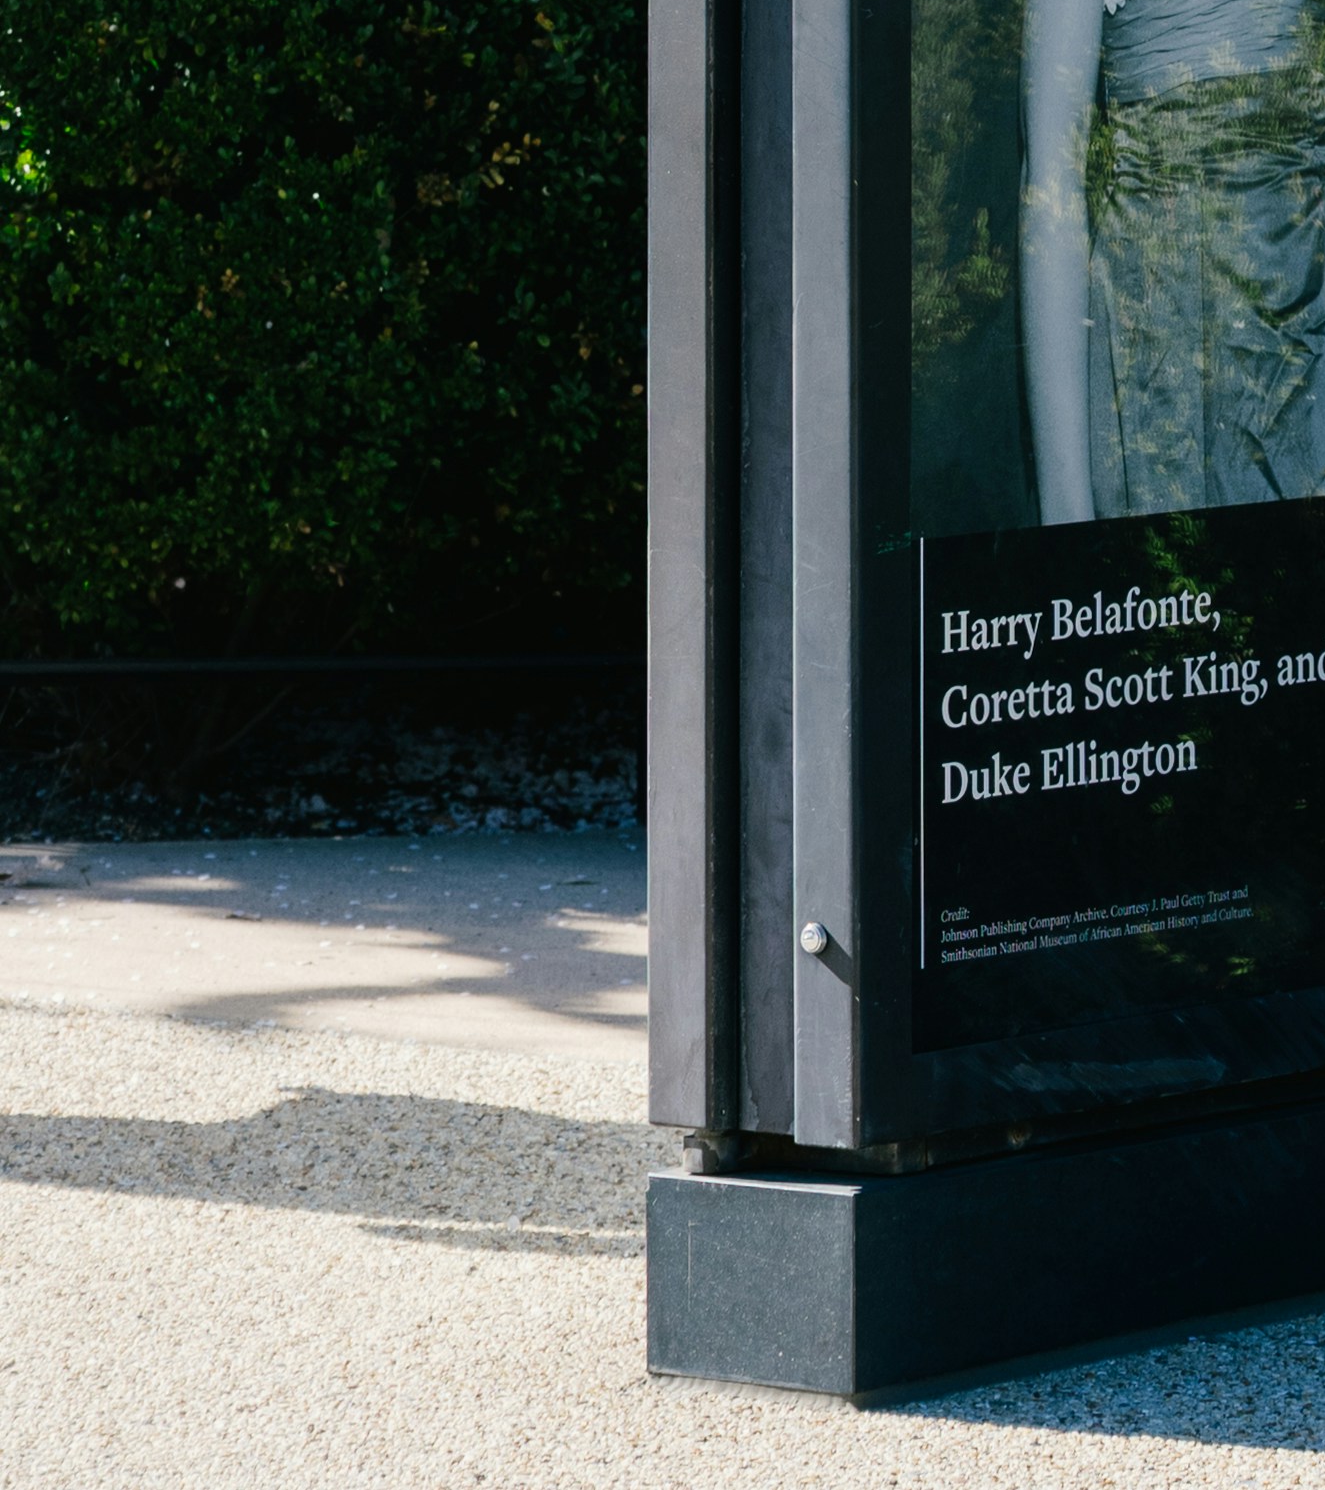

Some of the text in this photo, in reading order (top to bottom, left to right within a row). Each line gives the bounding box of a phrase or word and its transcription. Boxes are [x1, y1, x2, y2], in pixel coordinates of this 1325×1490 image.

[941, 586, 1221, 660] Harry Belafonte,
[941, 680, 1075, 729] Coretta
[1084, 664, 1173, 712] Scott
[1182, 651, 1269, 706] King,
[941, 738, 1198, 804] Duke Ellington
[941, 928, 978, 943] Johnson
[980, 919, 1027, 936] Publishing
[1029, 914, 1071, 930] Company
[1110, 903, 1149, 918] Courtesy
[1151, 899, 1158, 911] J.
[1160, 895, 1179, 910] Paul
[1181, 893, 1206, 908] Getty
[1207, 890, 1230, 903] Trust
[1232, 885, 1248, 899] and
[941, 906, 970, 923] Credit:
[941, 944, 997, 963] Smithsonian
[1000, 937, 1037, 954] National
[1039, 933, 1077, 948] Museum
[1079, 929, 1089, 942] of
[1090, 926, 1122, 940] African
[1124, 920, 1165, 936] American
[1167, 915, 1198, 929] History
[1201, 909, 1217, 923] and
